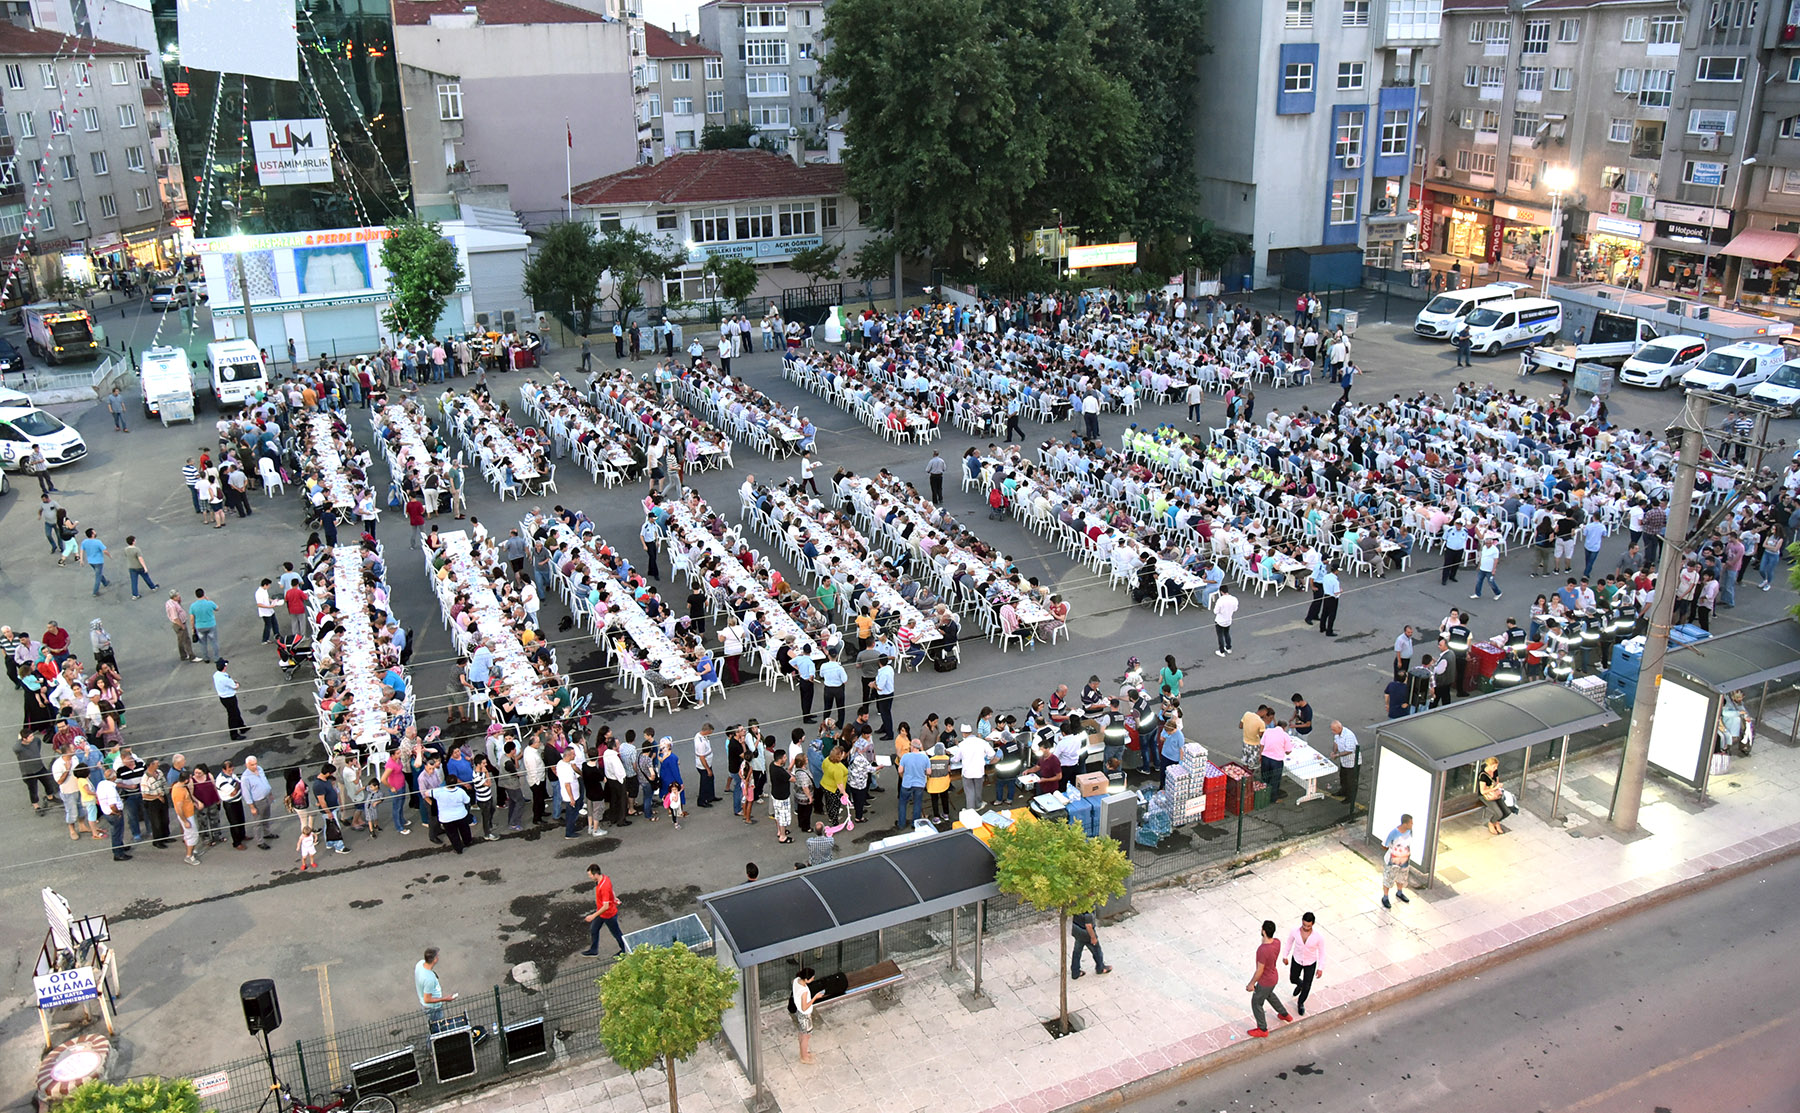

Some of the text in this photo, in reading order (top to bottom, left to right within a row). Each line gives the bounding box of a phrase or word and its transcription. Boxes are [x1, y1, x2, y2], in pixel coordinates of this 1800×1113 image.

[1422, 208, 1431, 241] arçelik
[1675, 226, 1704, 237] Hotpoint
[316, 232, 352, 245] PERDE
[791, 239, 819, 248] ÖĞRETİM
[1491, 224, 1501, 257] BOSC
[706, 245, 753, 255] MESLEKİ EĞİTİM
[218, 354, 257, 365] ZABITA
[50, 971, 78, 983] OTO
[39, 978, 93, 996] YIKAMA
[197, 1076, 225, 1088] ETİNKAYA
